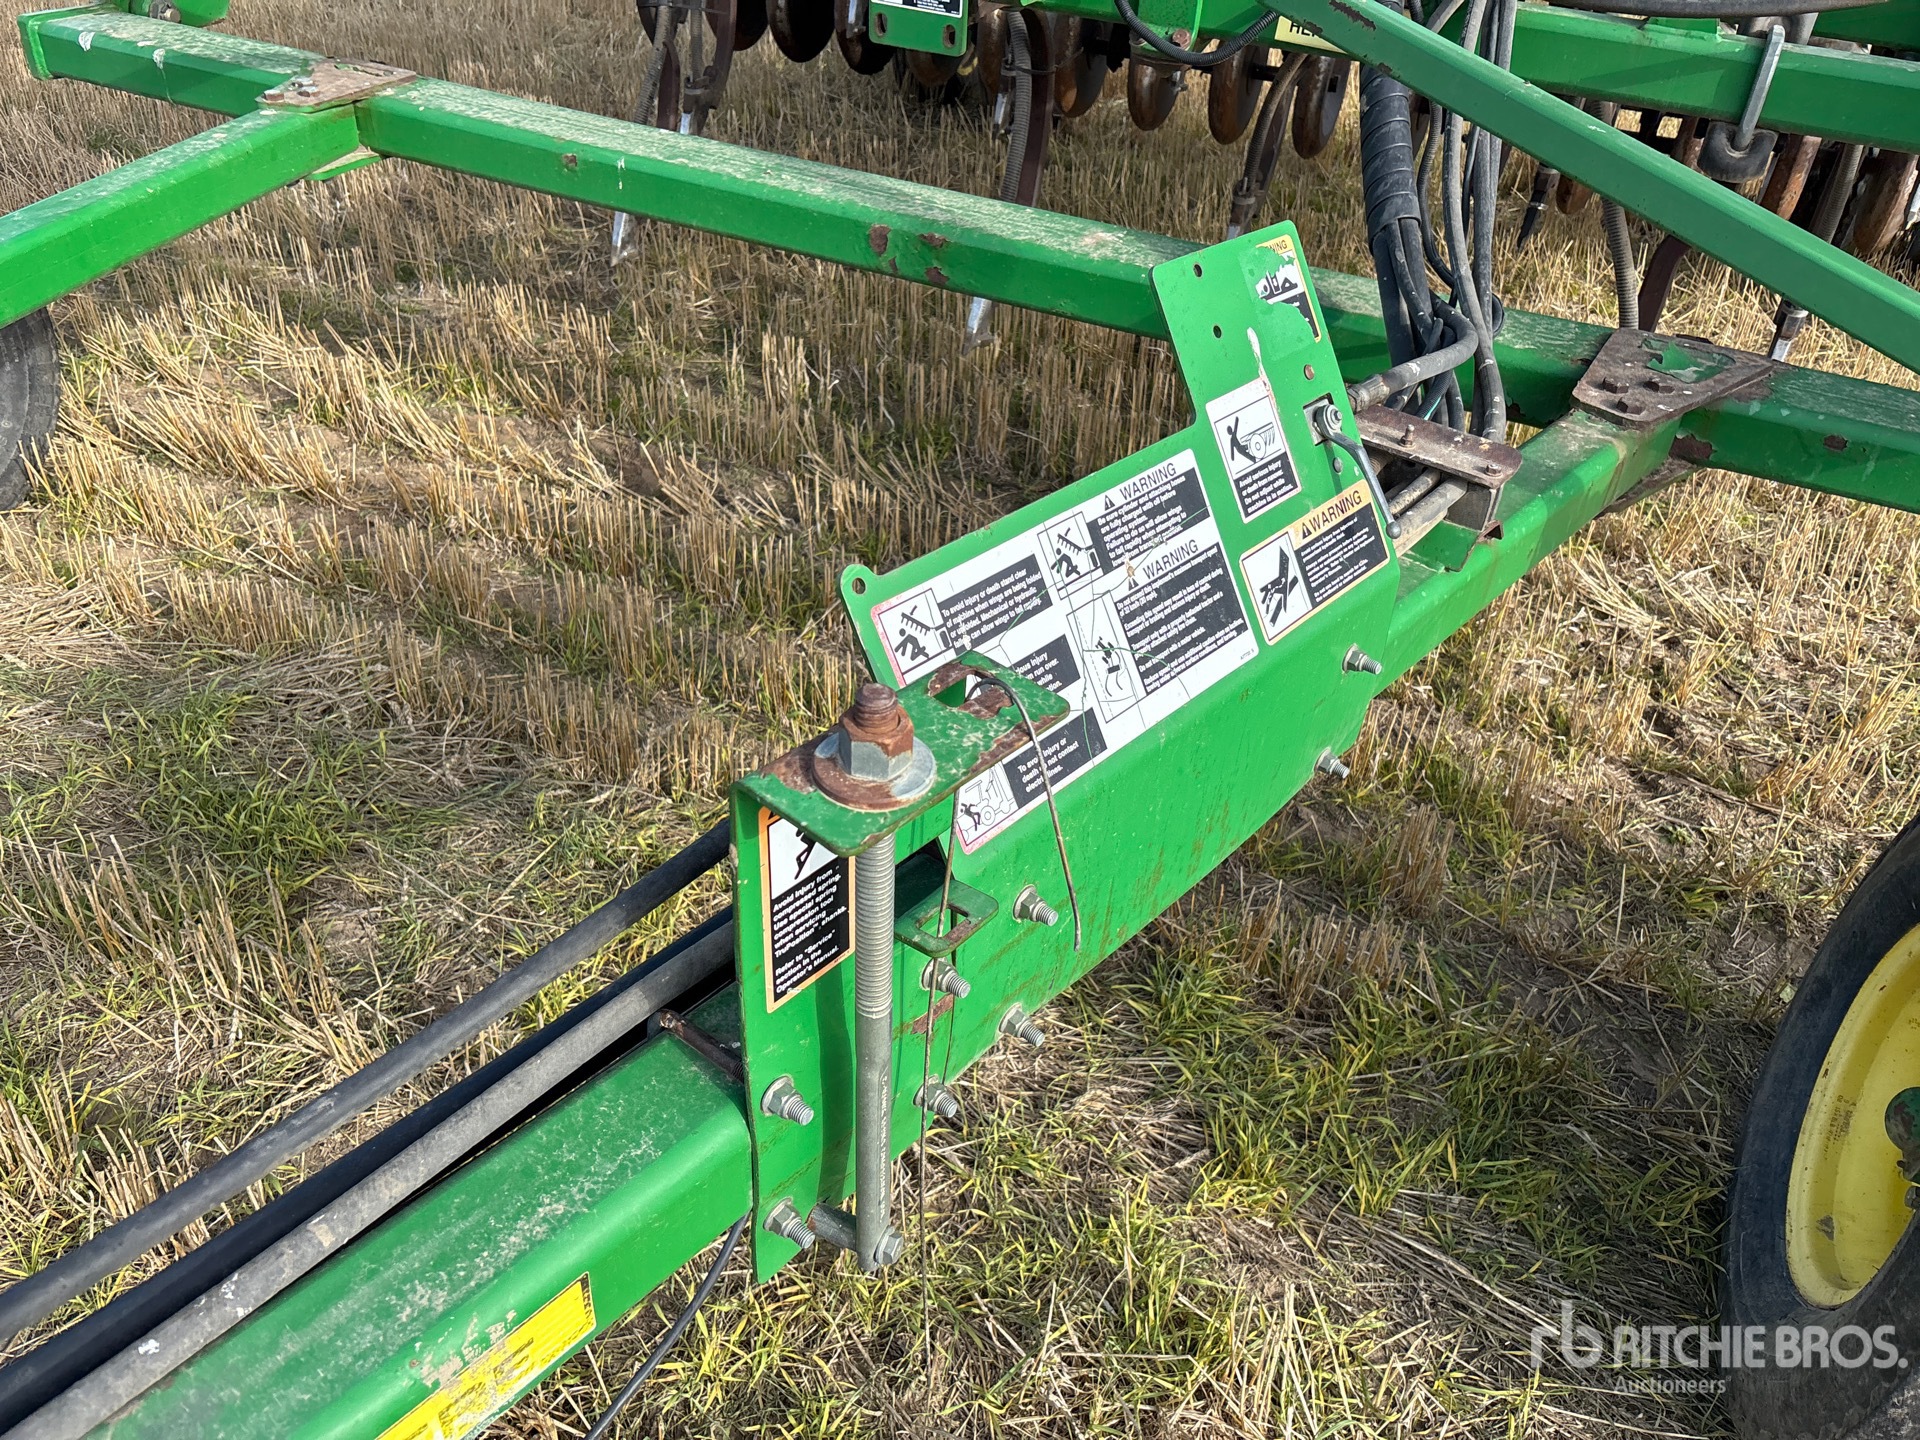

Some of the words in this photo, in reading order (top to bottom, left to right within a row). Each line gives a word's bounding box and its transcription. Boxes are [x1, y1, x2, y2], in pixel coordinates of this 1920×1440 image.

[1119, 462, 1177, 501] WARNING
[1309, 490, 1362, 533] WARNING
[1142, 539, 1199, 580] WARNING
[947, 619, 952, 628] of
[974, 601, 989, 612] when
[989, 593, 1004, 605] wings
[1004, 589, 1012, 597] are
[1012, 581, 1027, 592] being
[950, 601, 965, 614] avoid
[964, 594, 979, 606] injury
[986, 583, 1000, 594] death
[1000, 574, 1014, 587] stand
[1015, 569, 1026, 579] clear
[950, 630, 956, 638] or
[971, 630, 981, 639] can
[981, 622, 994, 633] allow
[994, 614, 1009, 626] wings
[1031, 653, 1047, 666] injury
[1034, 667, 1044, 676] run
[1045, 659, 1059, 670] over.
[1037, 674, 1052, 685] while
[1018, 765, 1026, 773] To
[1043, 743, 1059, 757] injury
[1022, 769, 1039, 783] death
[1048, 755, 1058, 766] not
[1058, 741, 1078, 759] contact
[1026, 776, 1044, 792] electri
[773, 894, 794, 912] Avoid
[794, 881, 815, 897] injury
[816, 870, 833, 882] from
[773, 889, 817, 921] compressed
[817, 874, 841, 891] spring.
[773, 919, 788, 930] Use
[788, 900, 814, 920] special
[815, 885, 837, 902] spring
[774, 907, 819, 939] compression
[820, 896, 834, 908] tool
[774, 933, 794, 948] when
[794, 911, 826, 935] servicing
[821, 907, 847, 925] shanks.
[775, 964, 802, 984] section
[810, 950, 822, 959] the
[775, 960, 795, 975] Refer
[776, 965, 813, 992] Operator's
[813, 946, 838, 966] Manual.
